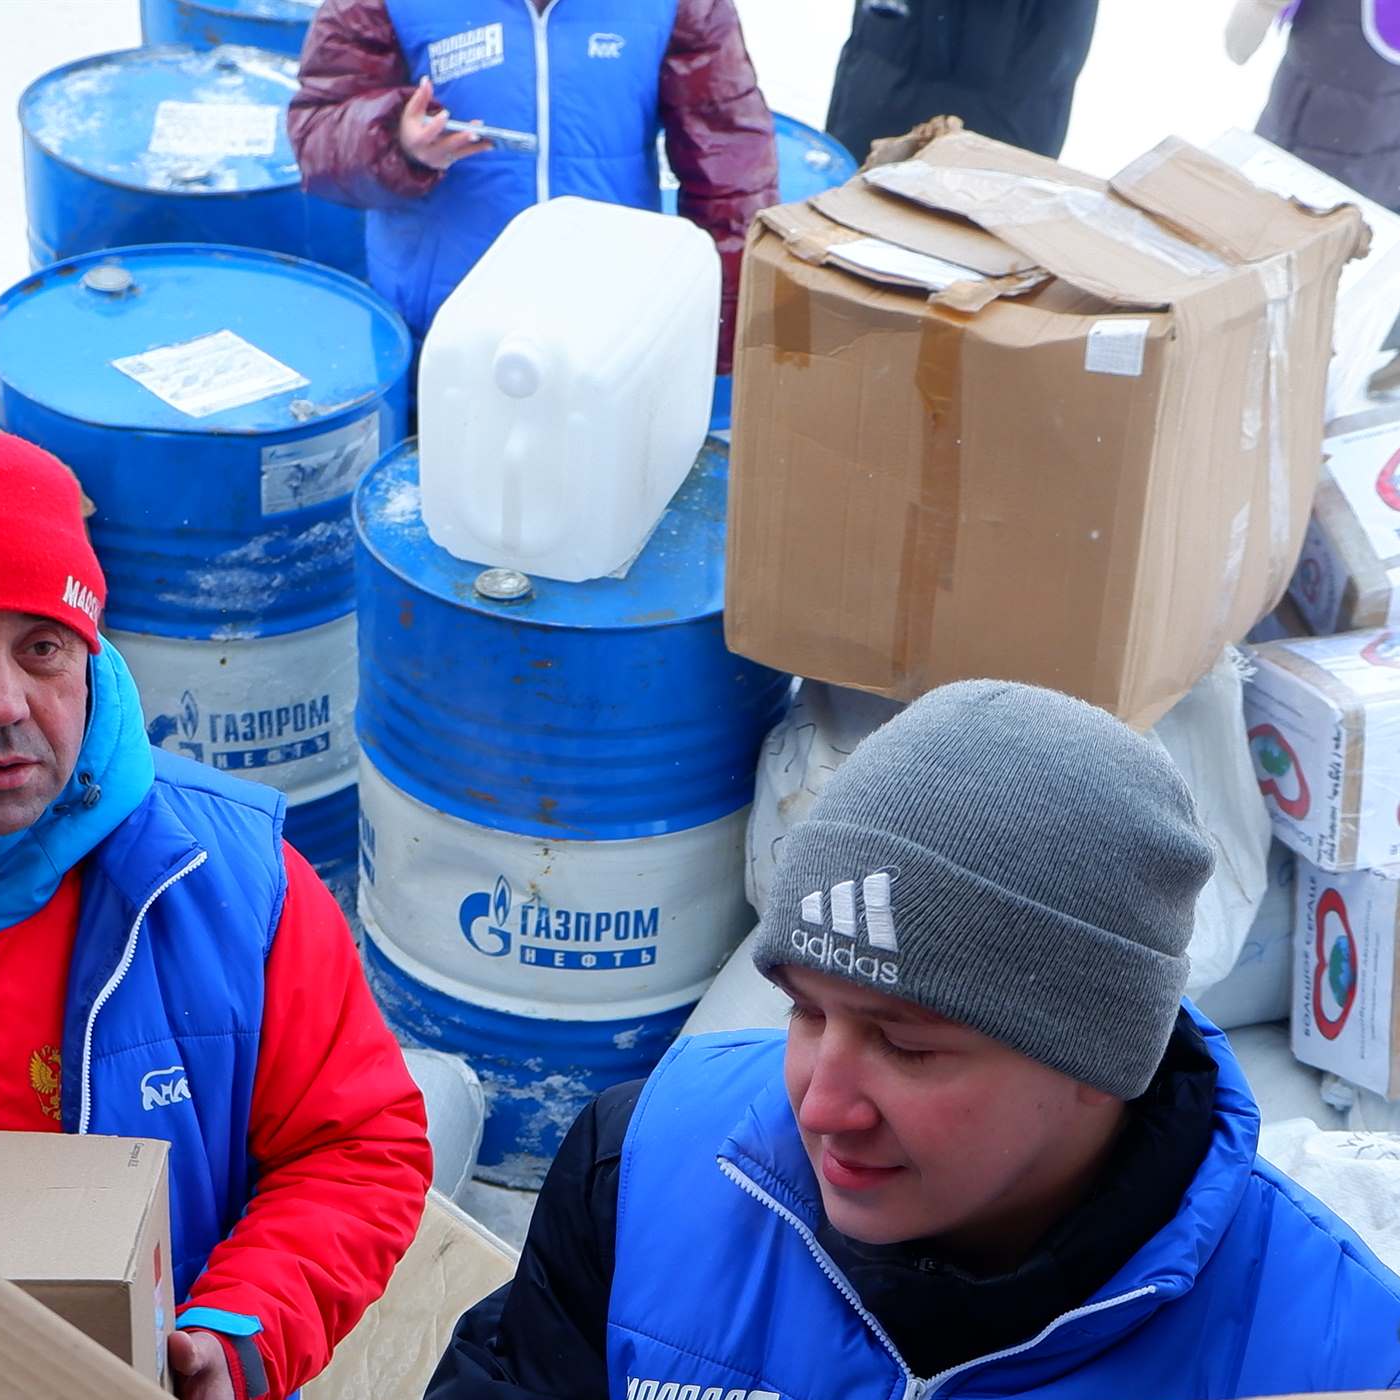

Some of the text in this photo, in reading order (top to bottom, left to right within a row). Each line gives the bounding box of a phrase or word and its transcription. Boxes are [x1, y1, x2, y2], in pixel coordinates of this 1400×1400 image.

[208, 695, 330, 743] ГАЗПРОМ
[519, 905, 660, 942] ГАЗПРОМ
[524, 949, 653, 968] НЕФТЬ
[791, 928, 899, 984] adidas
